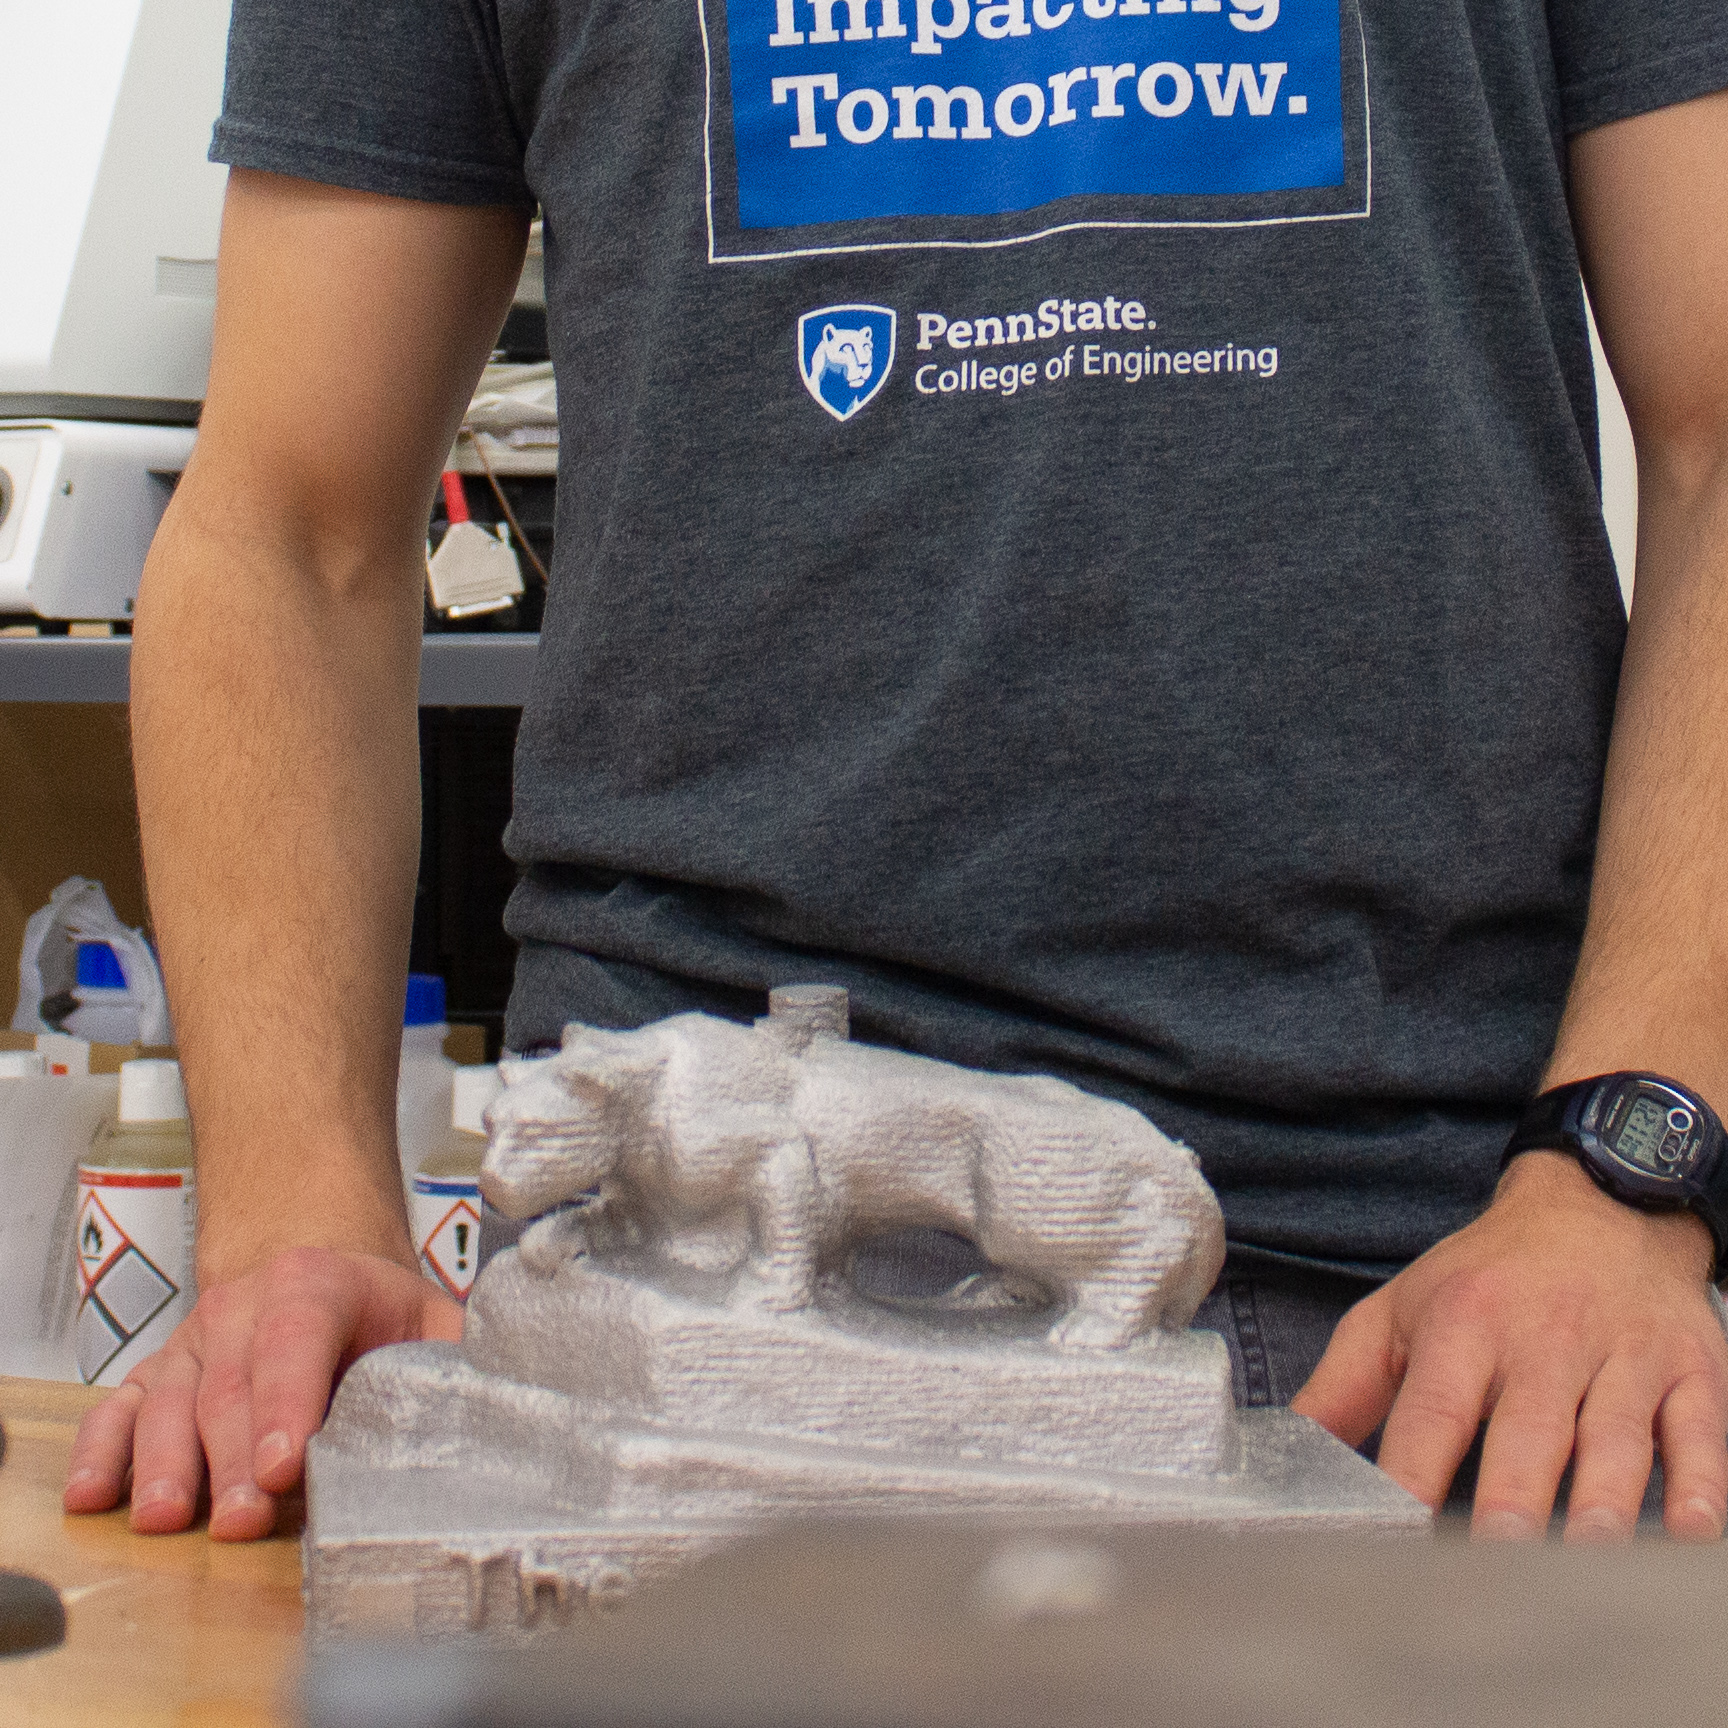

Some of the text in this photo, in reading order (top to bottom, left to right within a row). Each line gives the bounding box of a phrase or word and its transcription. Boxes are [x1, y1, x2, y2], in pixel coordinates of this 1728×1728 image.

[772, 60, 1308, 148] Tomorrow.
[914, 340, 1279, 397] College of Engineering
